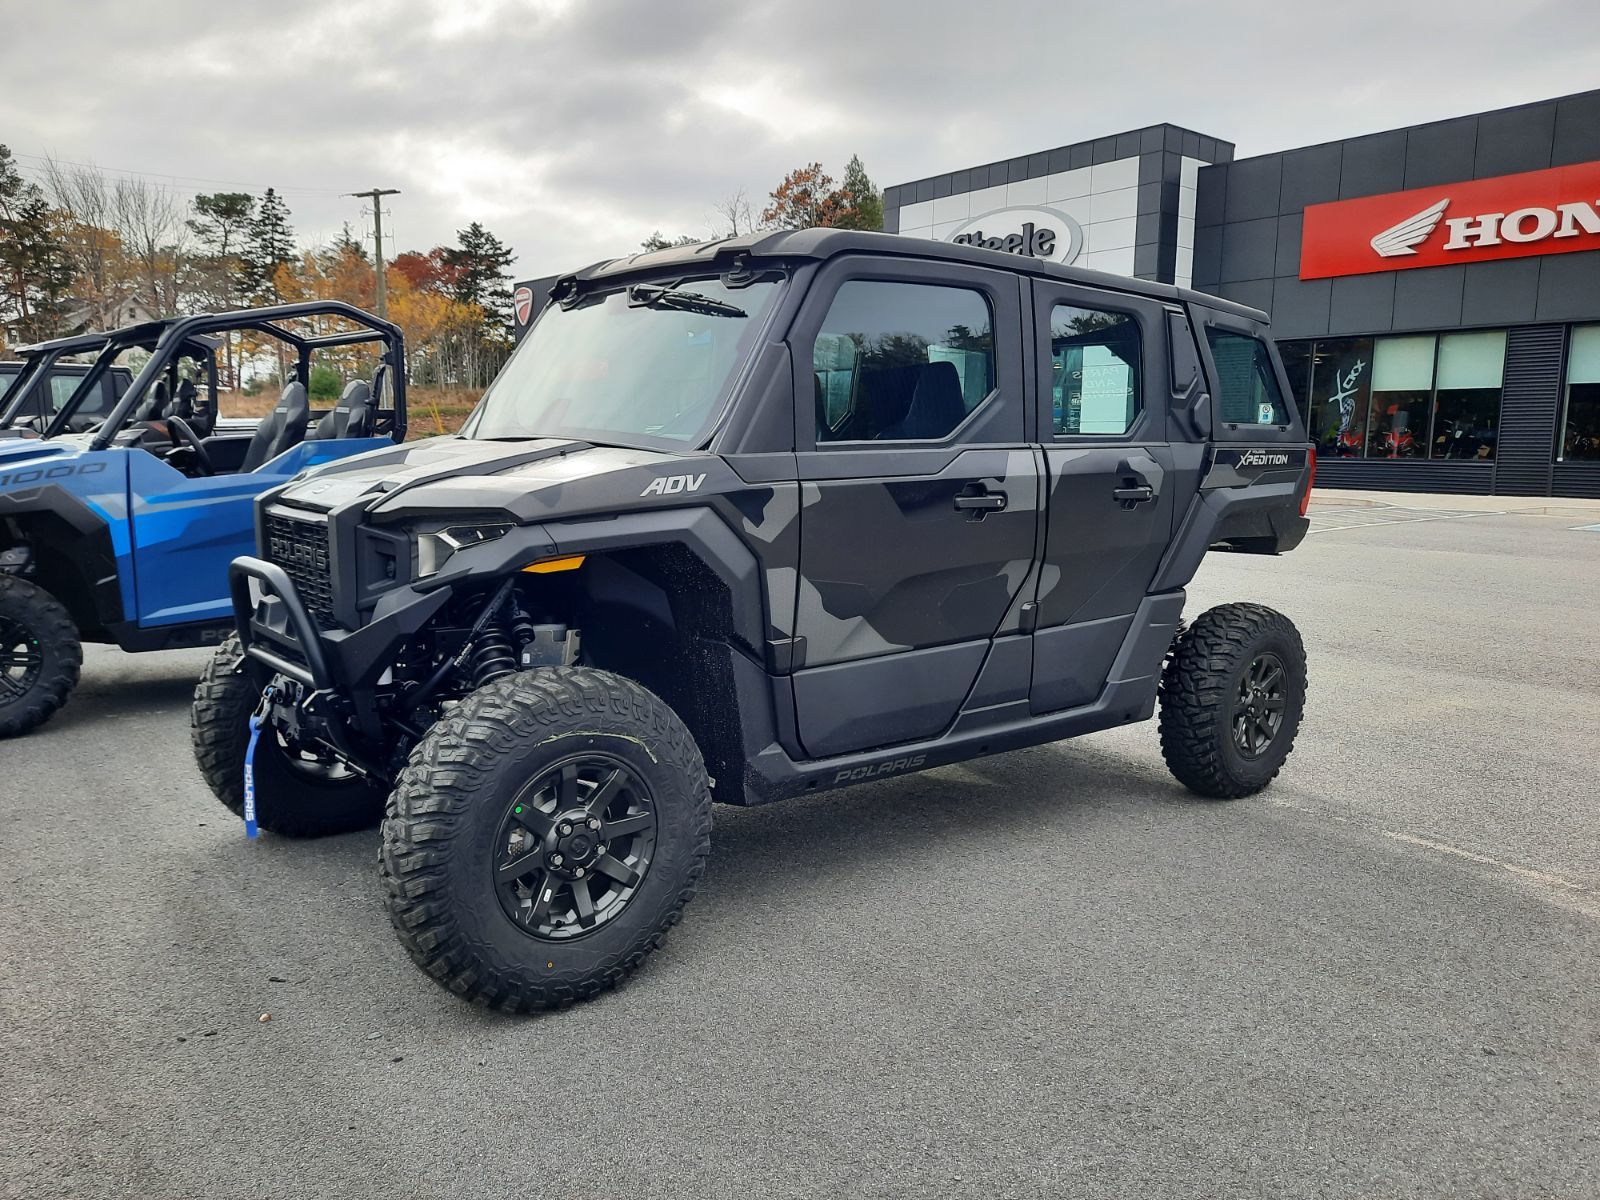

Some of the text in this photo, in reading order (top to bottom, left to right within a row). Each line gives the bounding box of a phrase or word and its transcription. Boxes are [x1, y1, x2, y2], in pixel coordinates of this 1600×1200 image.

[1235, 450, 1288, 470] XPEDITION
[1, 462, 107, 486] 1000
[639, 473, 707, 497] ADV
[833, 754, 927, 785] POLARIS
[244, 764, 255, 821] POLARIS
